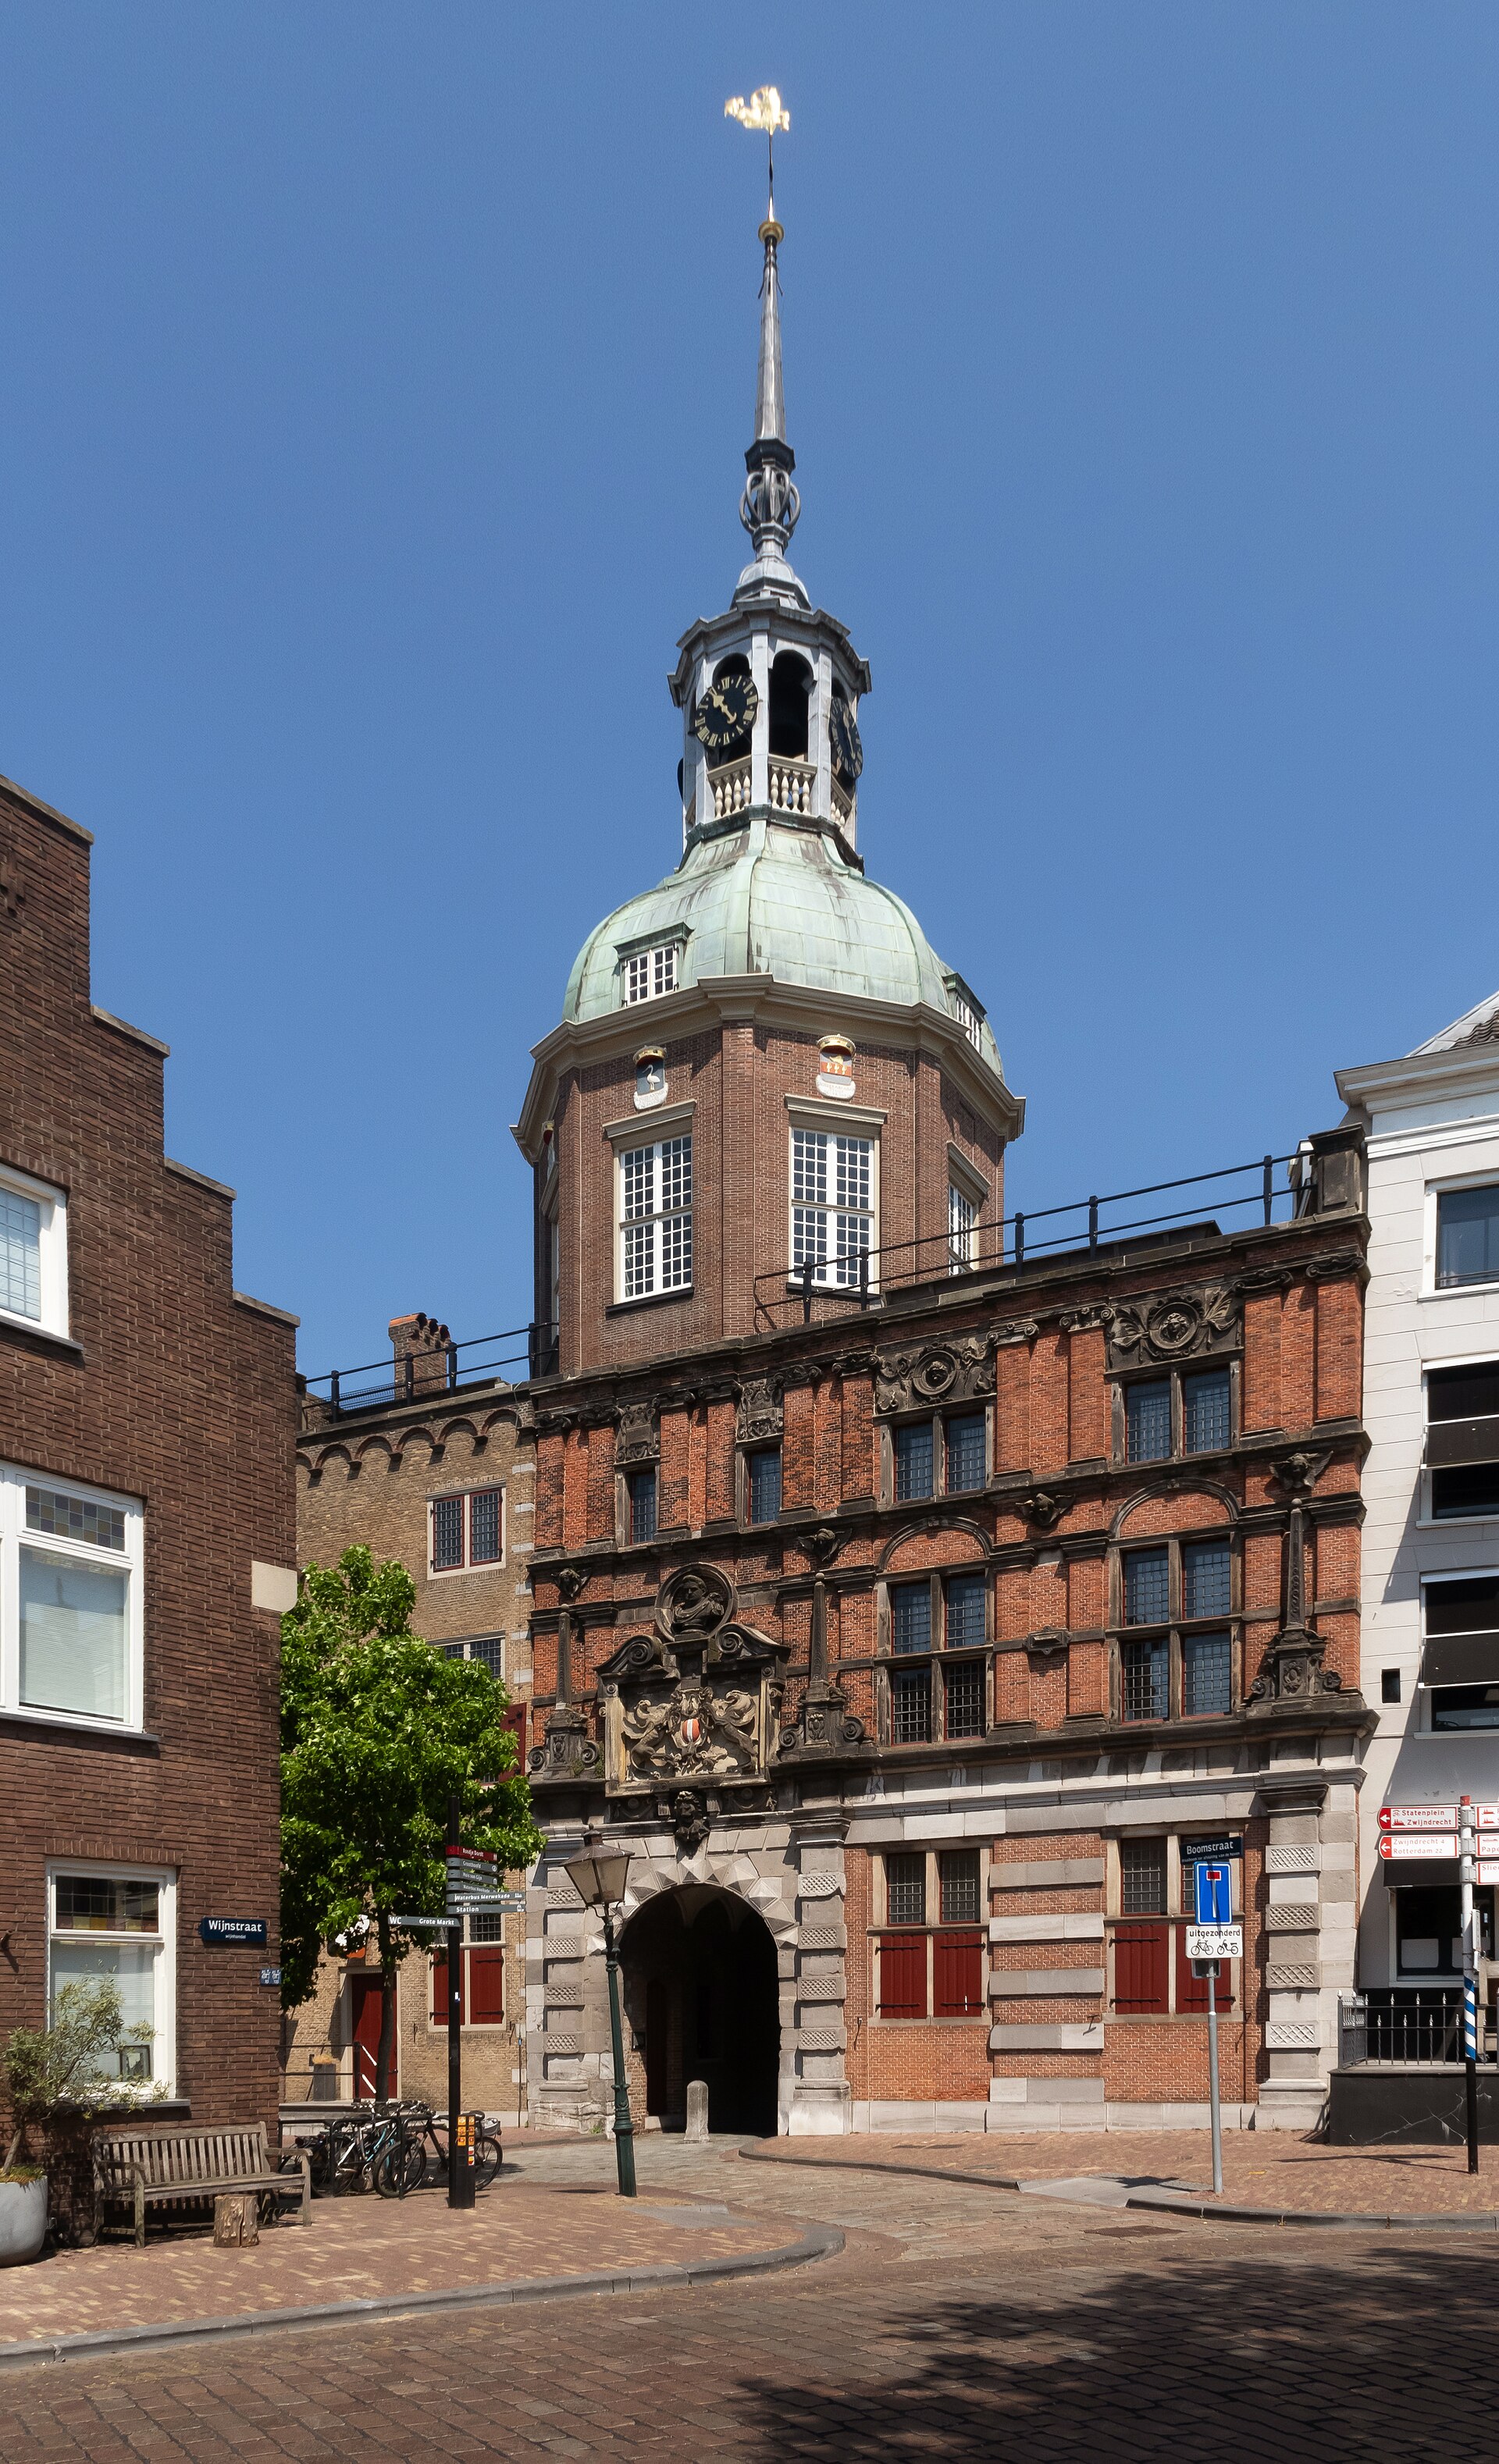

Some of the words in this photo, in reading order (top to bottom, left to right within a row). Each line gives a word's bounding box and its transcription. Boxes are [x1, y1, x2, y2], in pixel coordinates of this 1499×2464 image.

[1187, 1841, 1234, 1854] Boomstraat
[208, 1920, 262, 1932] Wijnstraat
[390, 1916, 402, 1925] WC
[1189, 1929, 1241, 1939] uitgezonderd
